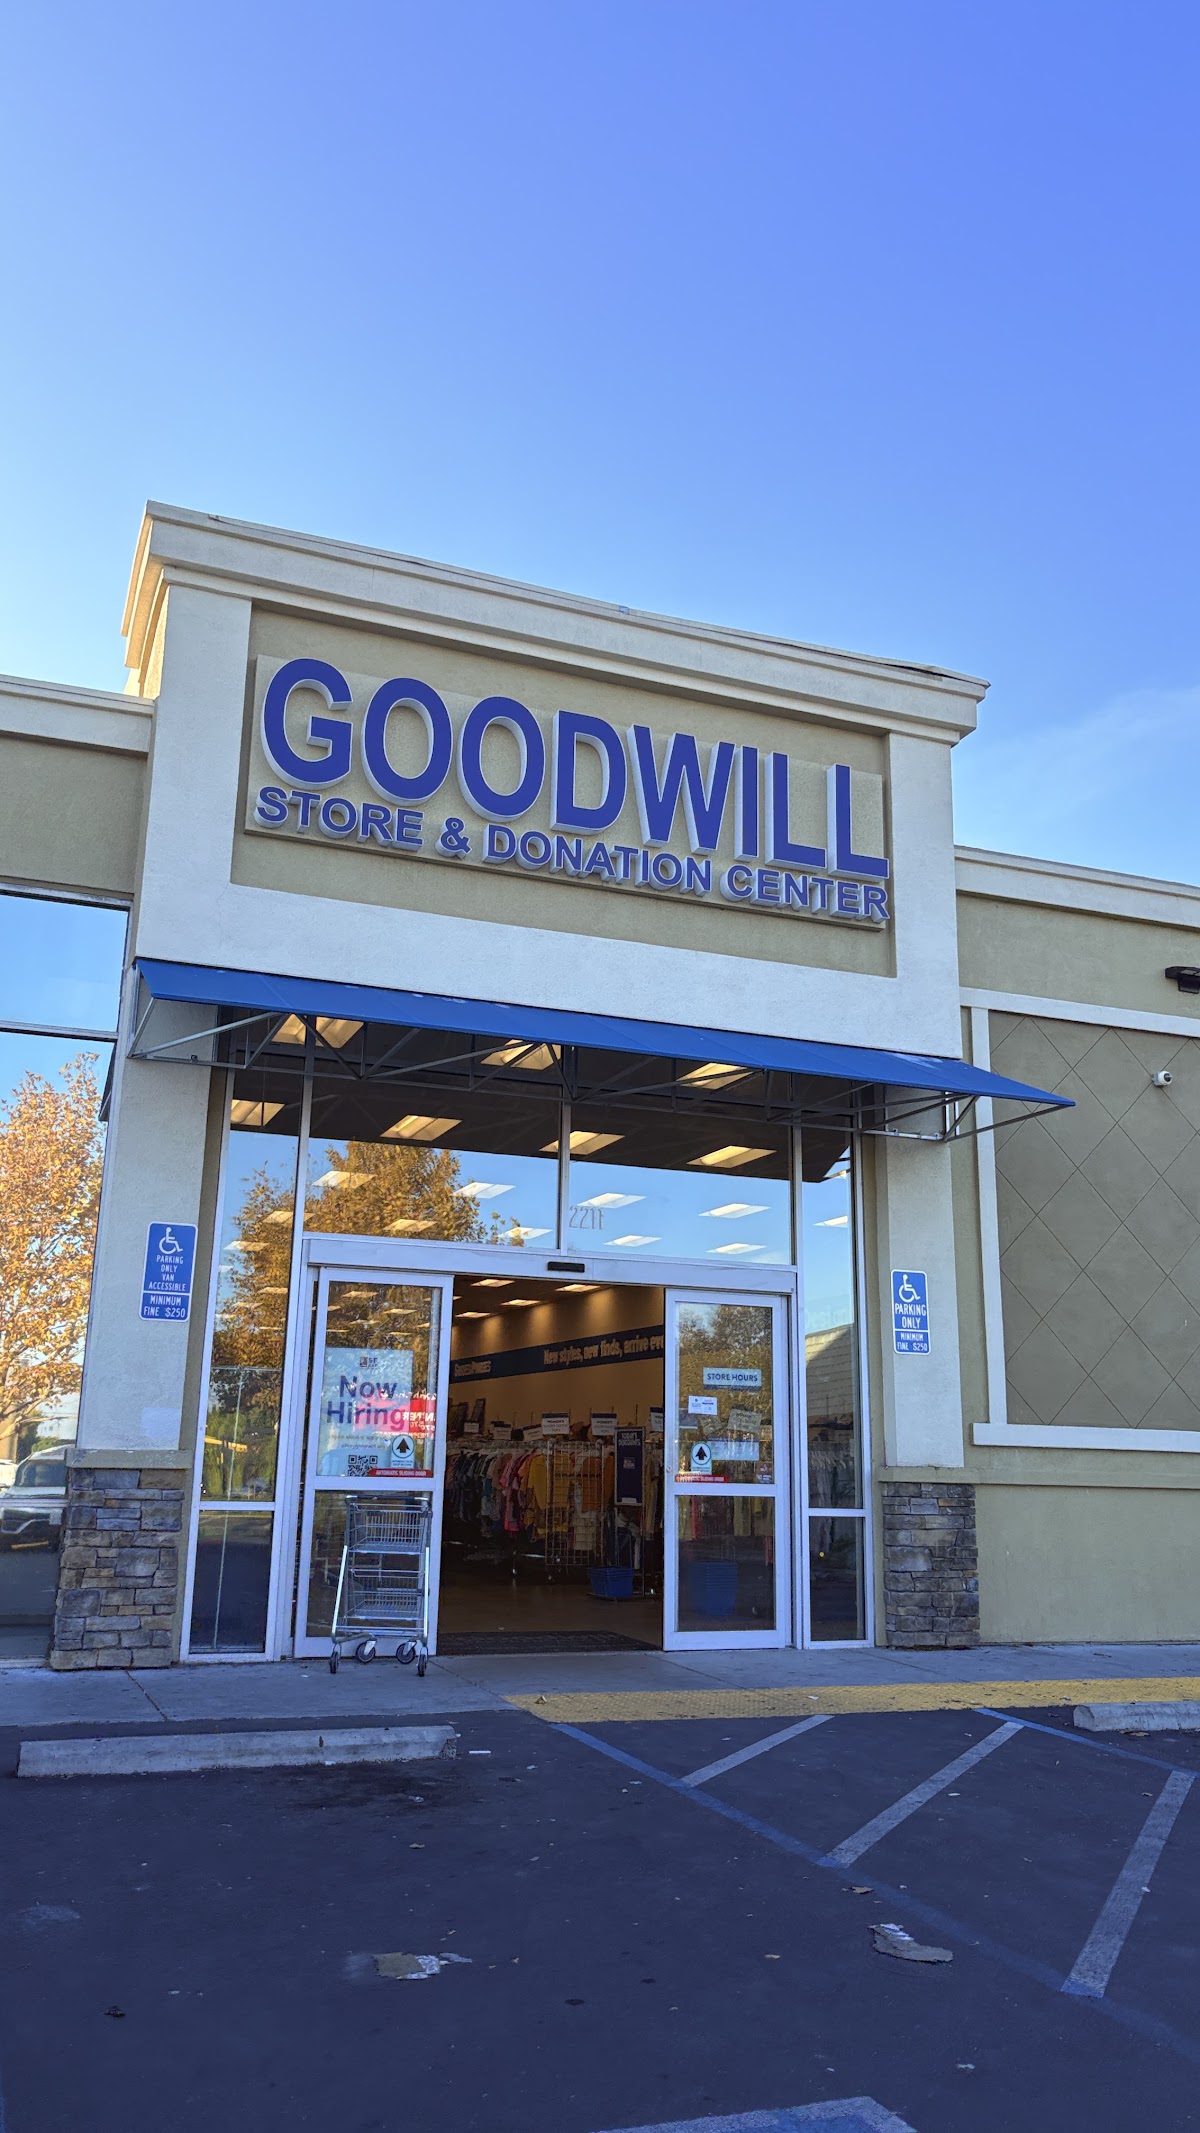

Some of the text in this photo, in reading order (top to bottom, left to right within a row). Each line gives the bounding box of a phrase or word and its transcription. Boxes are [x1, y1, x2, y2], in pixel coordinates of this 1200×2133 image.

[260, 658, 889, 880] GOODWILL
[254, 787, 889, 923] STORE & DONATION CENTER
[156, 1255, 184, 1264] PARKING
[160, 1264, 178, 1272] ONLY
[162, 1273, 175, 1281] VAN
[148, 1282, 187, 1291] ACCESSIBLE
[150, 1295, 182, 1305] MINIMUM
[143, 1307, 186, 1318] FINE $250
[894, 1303, 926, 1316] PARKING
[901, 1316, 921, 1329] ONLY
[900, 1333, 924, 1341] MINIMUM
[896, 1342, 909, 1351] FINE
[544, 1349, 559, 1365] New
[584, 1345, 599, 1359] new
[707, 1373, 758, 1382] STORE HOURS
[340, 1375, 398, 1399] Now
[326, 1401, 405, 1431] Hiring
